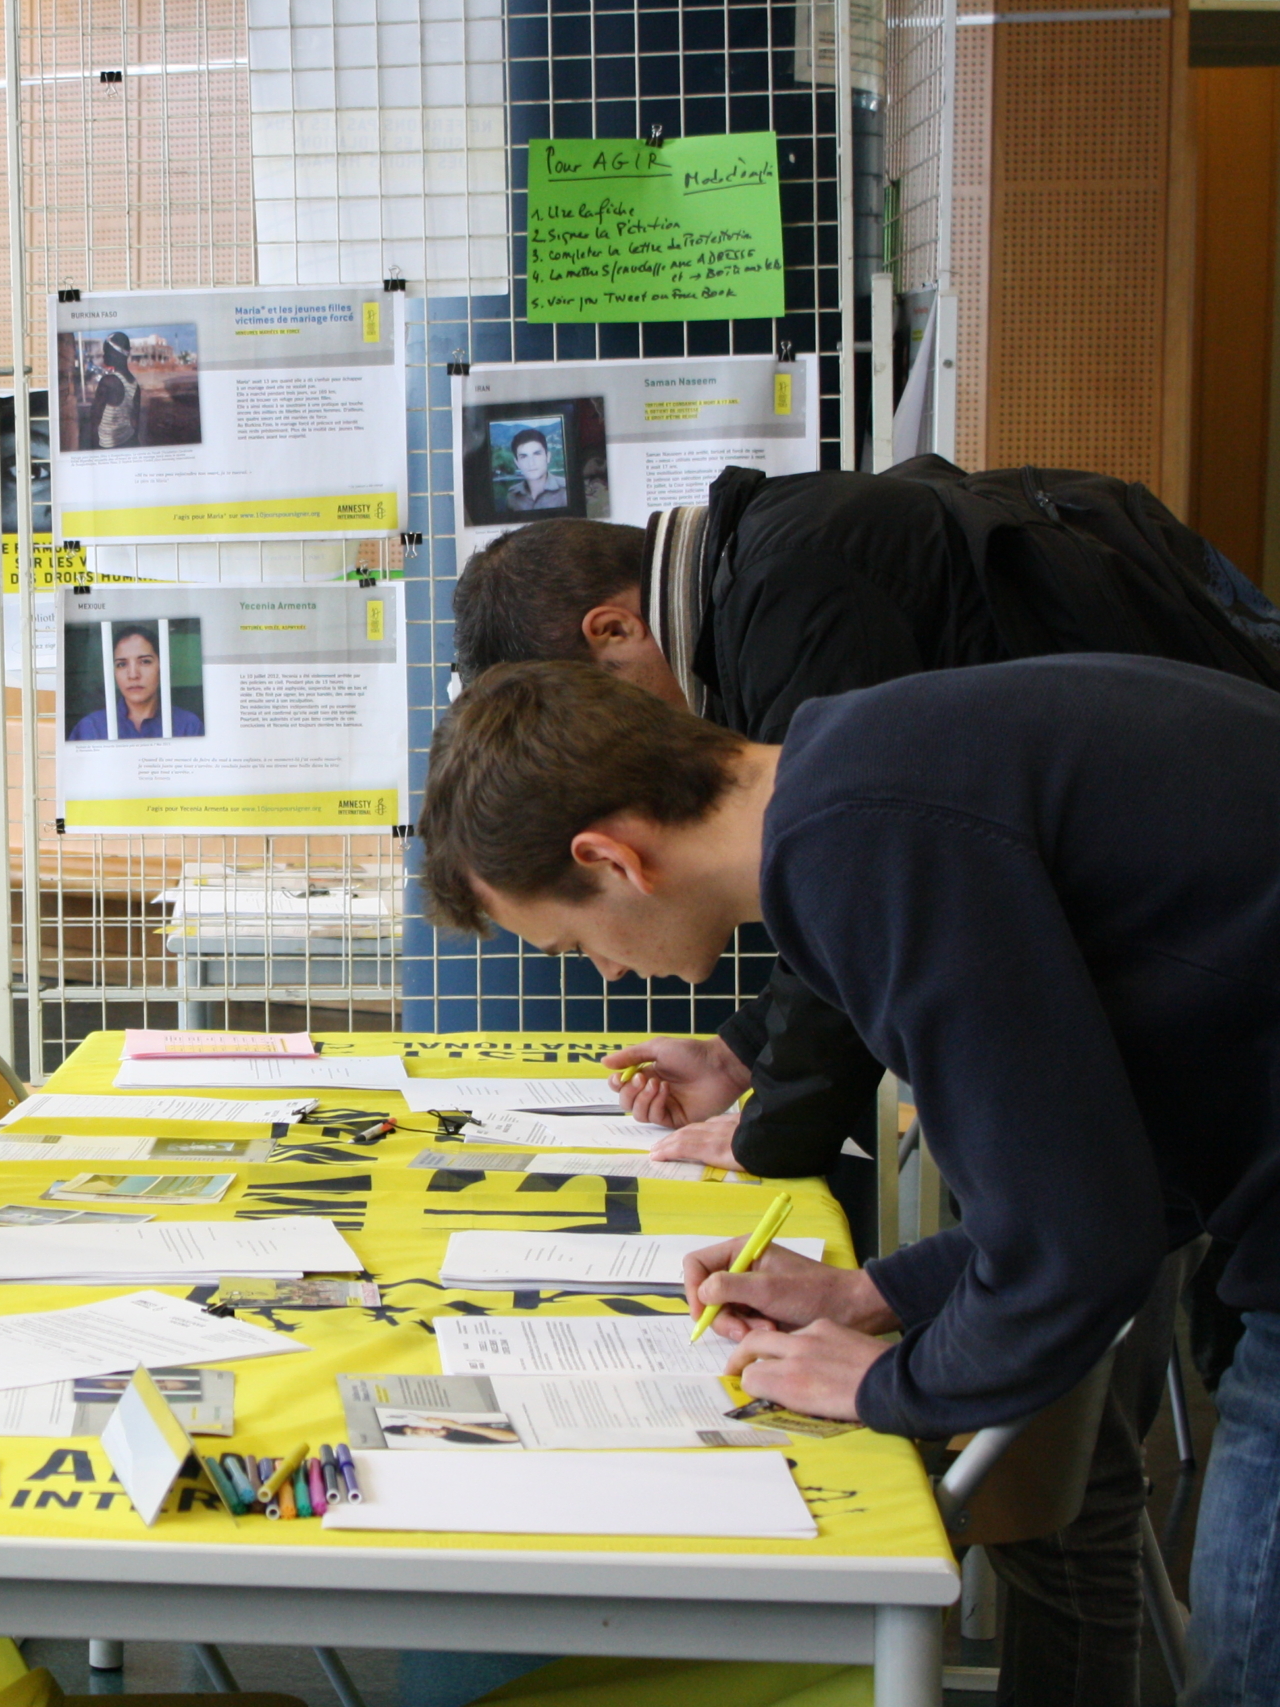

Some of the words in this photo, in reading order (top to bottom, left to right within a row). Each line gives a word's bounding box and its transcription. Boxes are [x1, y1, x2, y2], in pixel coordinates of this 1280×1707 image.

[546, 146, 581, 174] Pour
[593, 152, 671, 171] AGIR
[595, 227, 610, 239] la
[532, 248, 543, 263] 3.
[608, 245, 620, 256] la
[532, 270, 543, 283] 4.
[604, 292, 647, 303] Tweet
[279, 306, 293, 314] les
[294, 305, 326, 315] jeunes
[328, 304, 352, 312] filles
[235, 315, 275, 325] victimes
[276, 315, 288, 323] de
[290, 314, 328, 325] mariage
[329, 312, 354, 322] forcé
[644, 378, 676, 387] Saman
[679, 377, 717, 386] Naseem
[337, 504, 371, 513] AMNESTY
[49, 557, 73, 568] LES
[44, 571, 94, 584] DROITS
[239, 602, 276, 610] Yecenia
[277, 601, 317, 610] Armenta
[338, 800, 371, 808] AMNESTY
